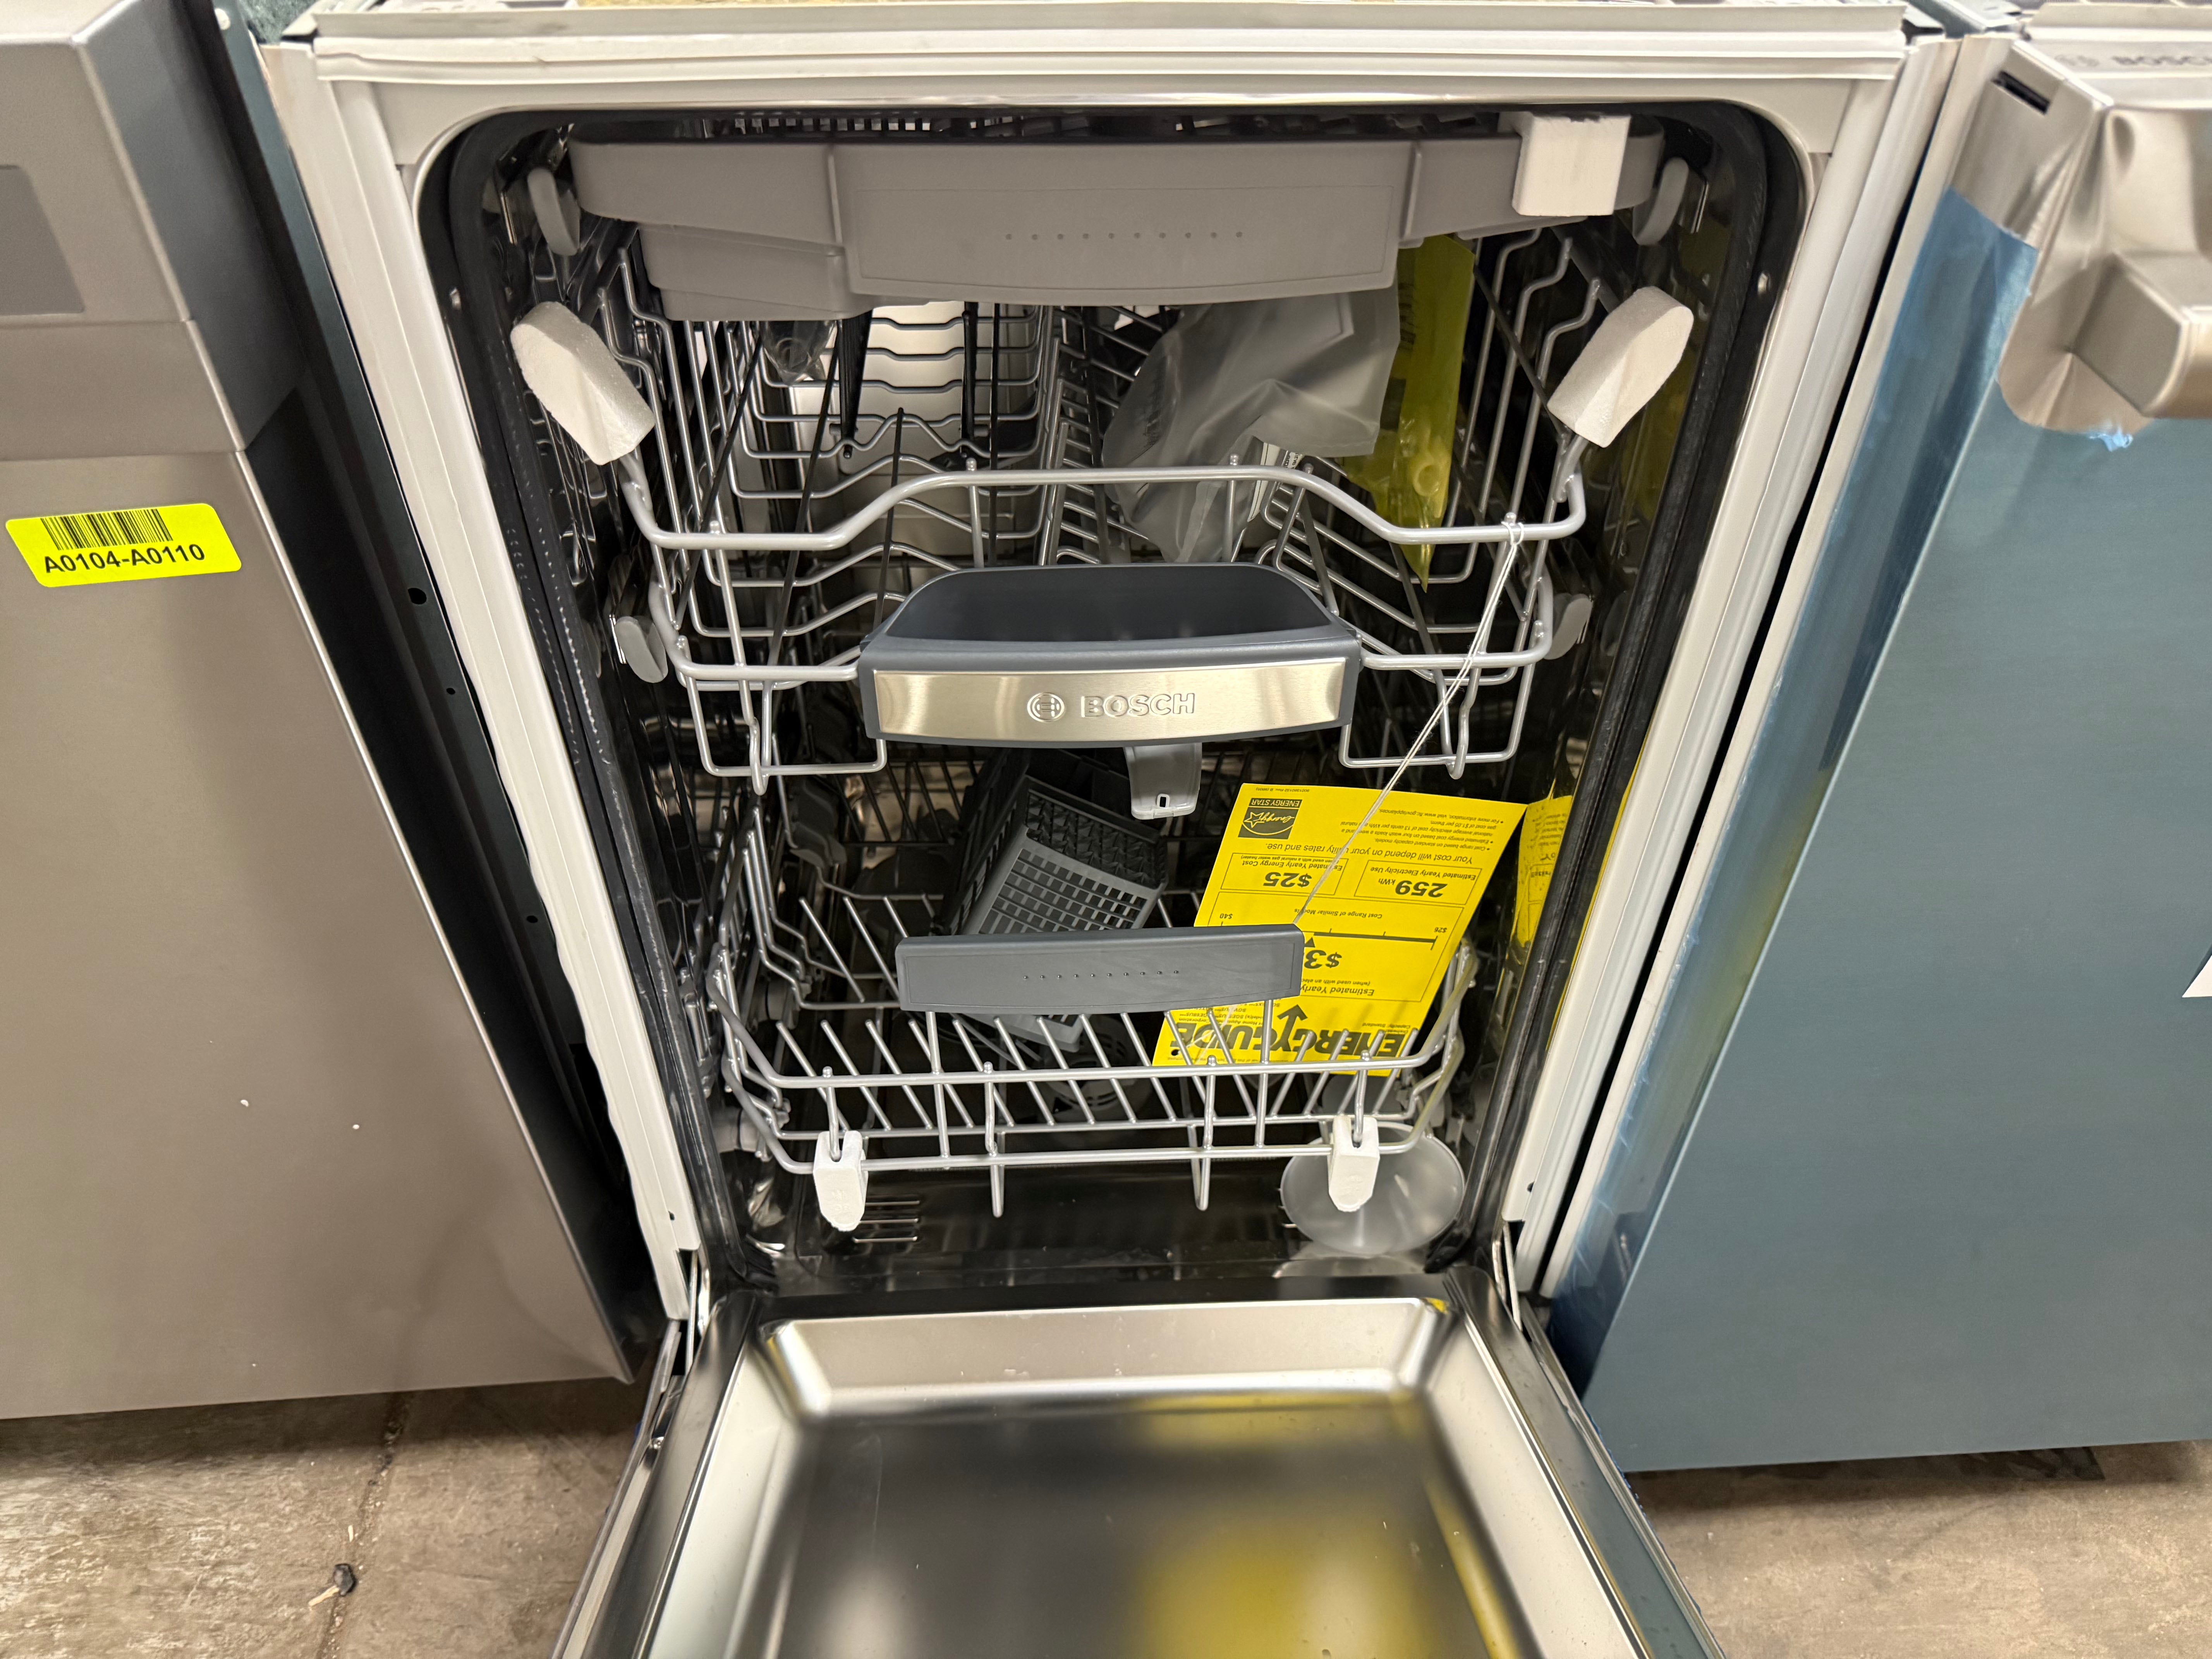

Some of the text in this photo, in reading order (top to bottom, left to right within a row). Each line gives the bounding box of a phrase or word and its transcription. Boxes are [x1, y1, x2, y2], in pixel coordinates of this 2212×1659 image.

[45, 543, 205, 574] A0104-A0110
[1081, 692, 1195, 718] BOSCH
[1259, 812, 1295, 823] energy
[1384, 850, 1417, 859] depend
[1384, 867, 1419, 876] Electricity
[1420, 869, 1441, 878] Yearly
[1443, 872, 1476, 881] Estimated
[1263, 872, 1312, 888] $25
[1395, 880, 1448, 898] 259
[1304, 950, 1342, 969] $3
[1300, 984, 1374, 996] Estimated Yearly
